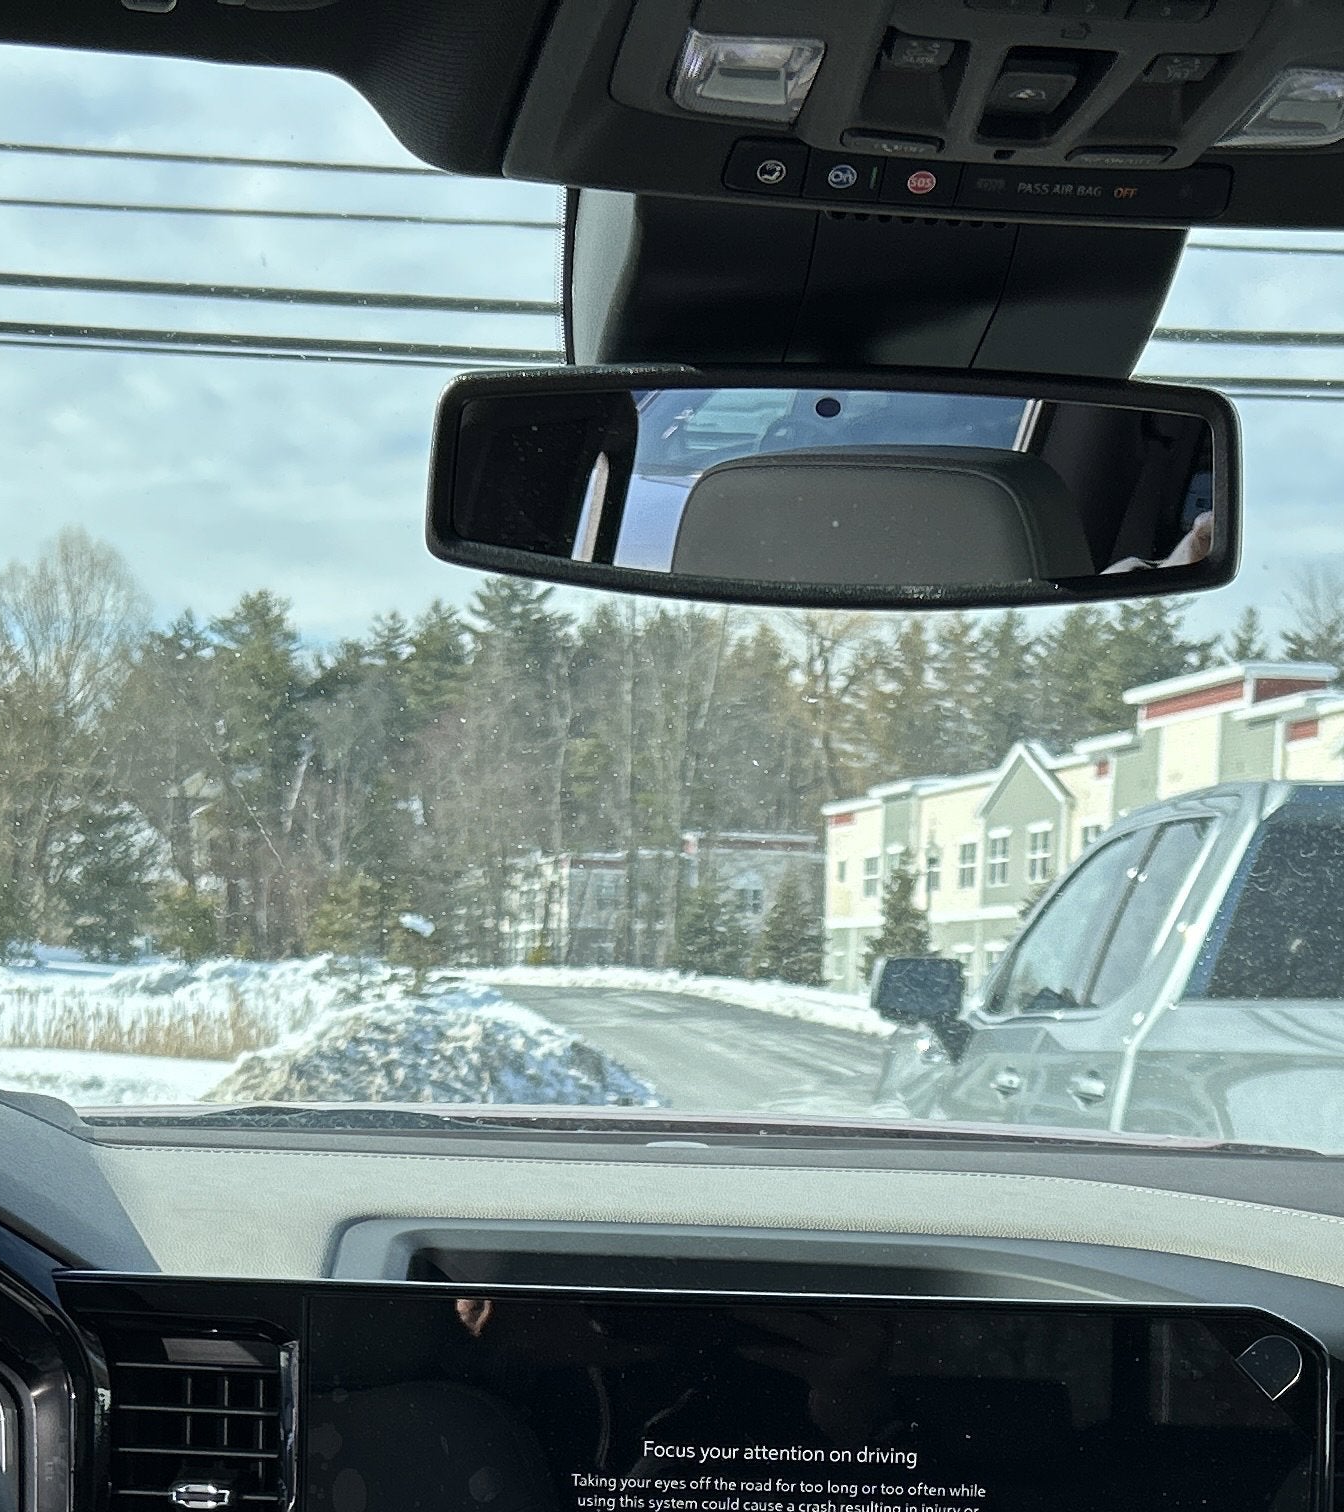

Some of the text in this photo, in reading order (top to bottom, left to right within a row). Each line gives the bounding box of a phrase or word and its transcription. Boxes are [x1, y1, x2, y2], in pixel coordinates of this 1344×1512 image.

[909, 177, 936, 189] SOS
[1017, 182, 1050, 195] PASS
[1052, 183, 1074, 195] AIR
[1076, 186, 1103, 198] BAG
[1113, 186, 1138, 199] OFF
[642, 1440, 918, 1469] Focus your attention on driving
[570, 1473, 987, 1498] Taking your eyes off the road for too long or too often while
[577, 1494, 616, 1511] using
[619, 1495, 645, 1509] this
[648, 1498, 698, 1512] system
[701, 1497, 740, 1511] could
[743, 1500, 784, 1512] cause
[786, 1502, 795, 1512] a
